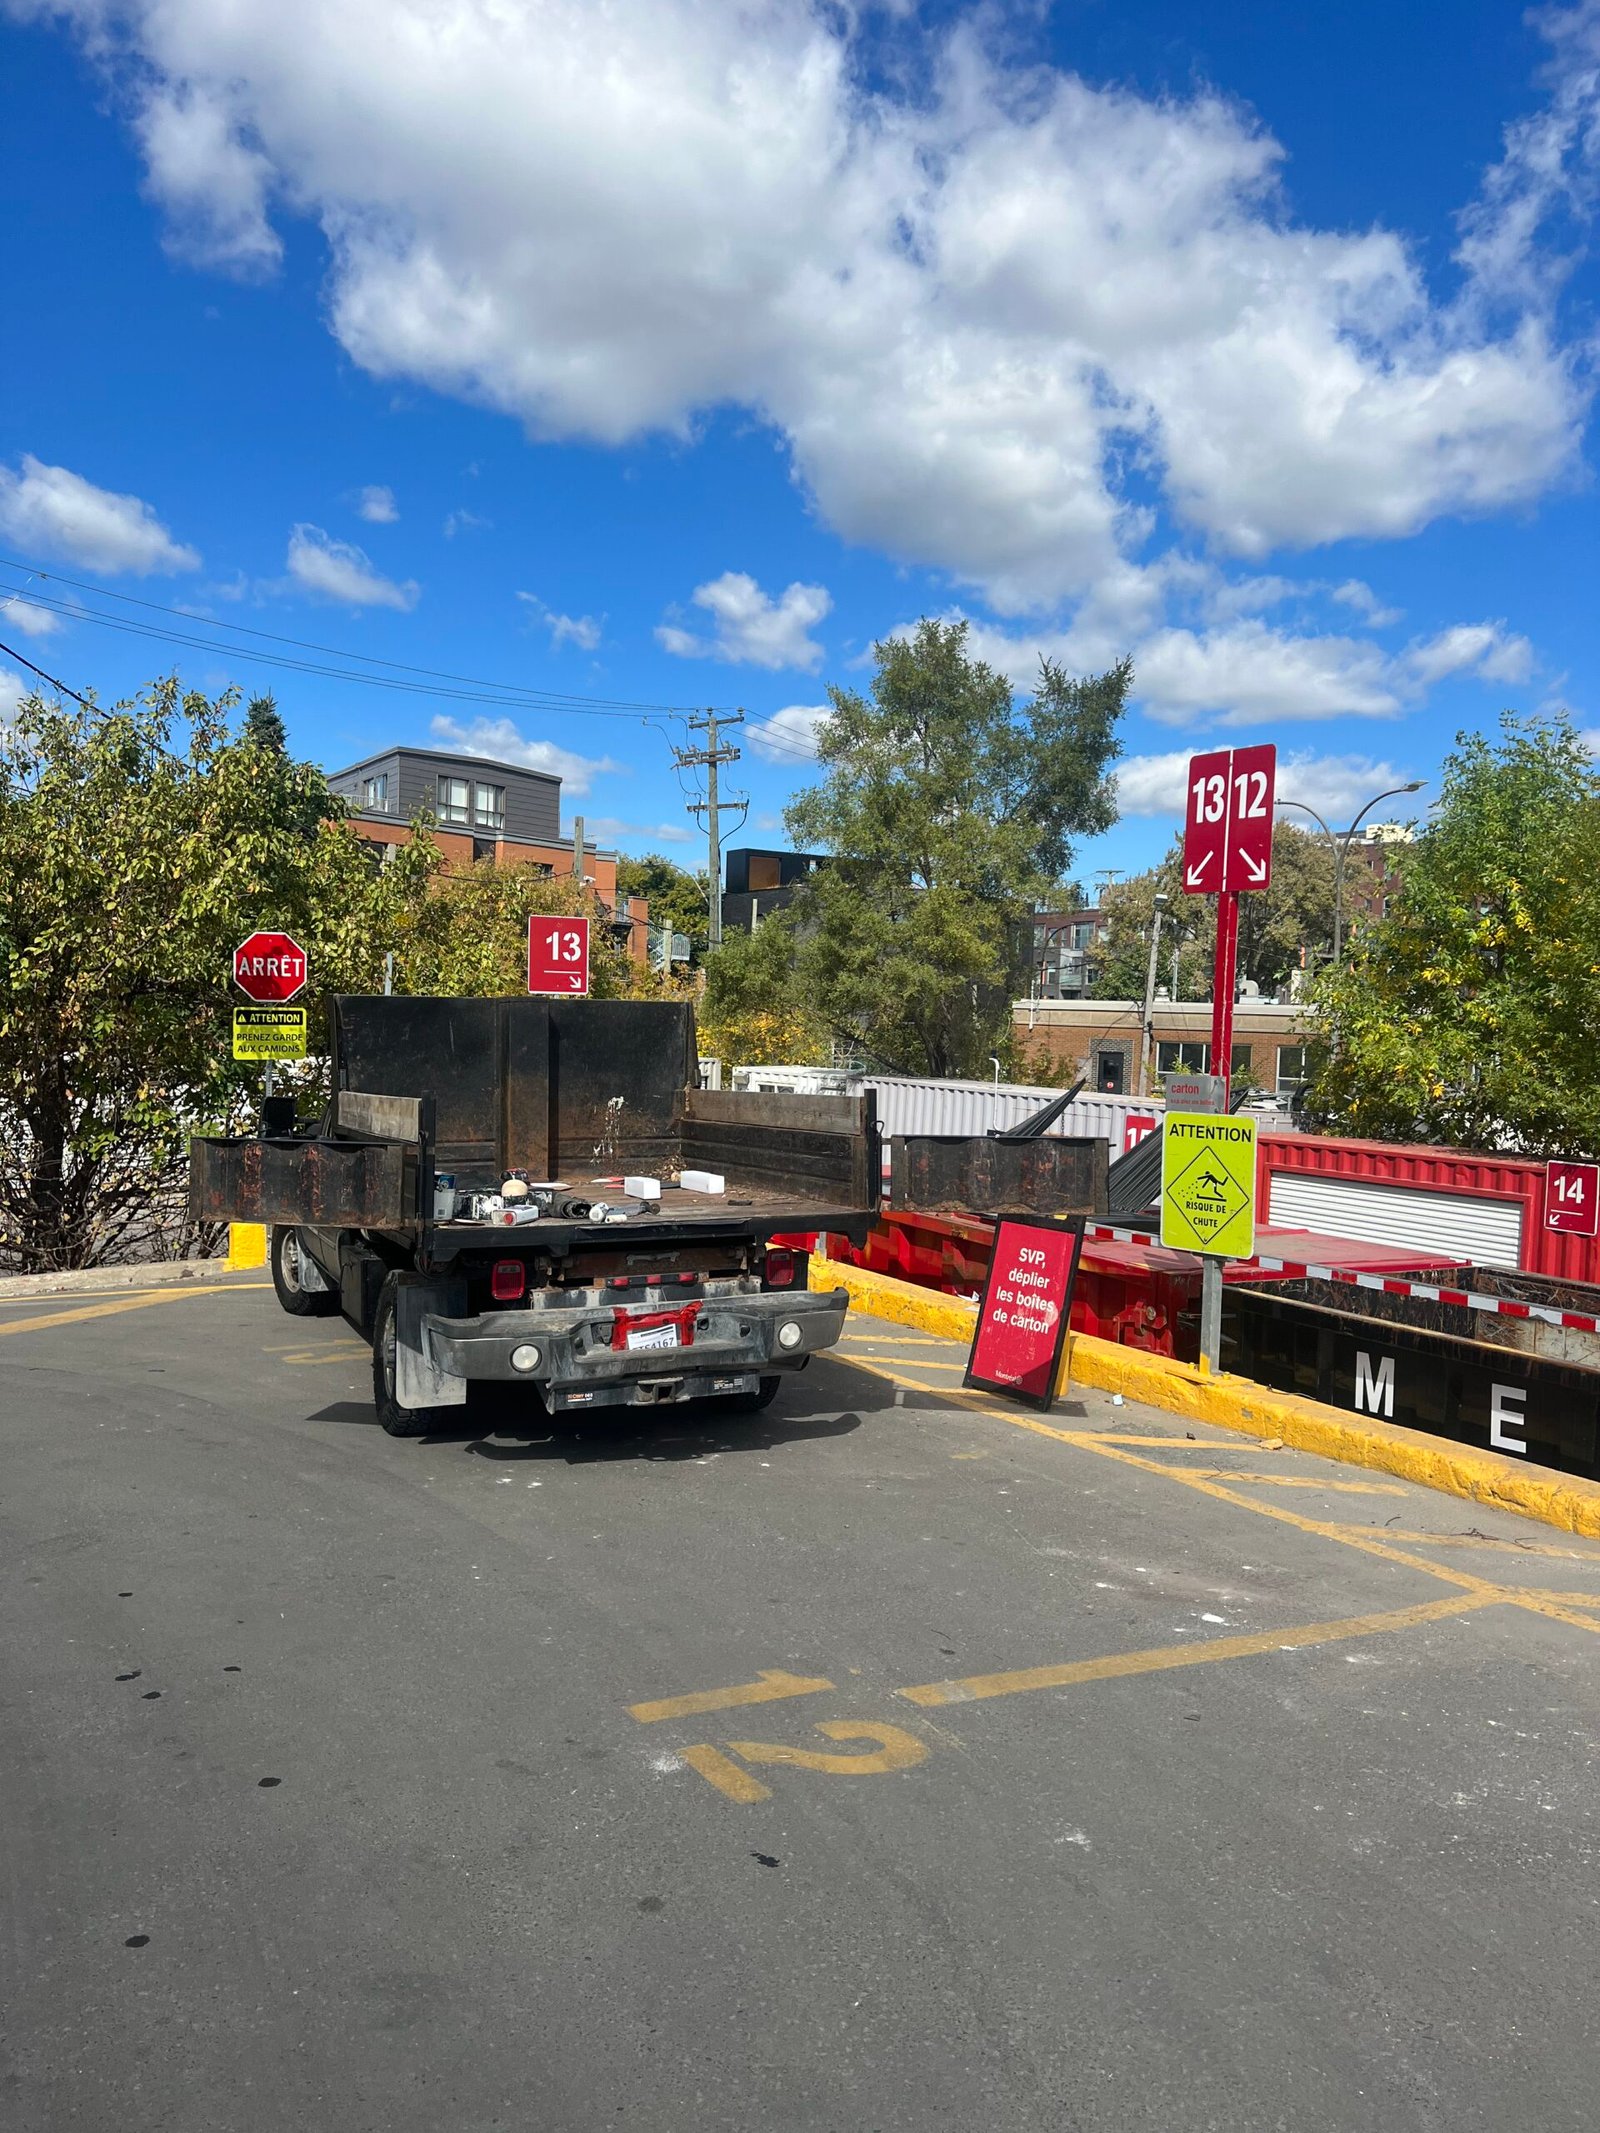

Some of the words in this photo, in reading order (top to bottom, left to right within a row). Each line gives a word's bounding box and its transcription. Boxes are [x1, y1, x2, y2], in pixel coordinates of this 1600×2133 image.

[1192, 774, 1225, 824] 13
[1234, 771, 1268, 819] 12
[546, 931, 582, 962] 13
[238, 955, 303, 977] ARRÊT
[249, 1013, 300, 1023] ATTENTION
[236, 1033, 271, 1042] PRENEZ
[272, 1033, 303, 1042] GARDE
[237, 1044, 257, 1053] AUX
[1171, 1084, 1199, 1095] carton
[1169, 1123, 1252, 1143] ATTENTION
[1554, 1175, 1585, 1204] 14
[1185, 1201, 1214, 1213] RISQUE
[1216, 1203, 1227, 1214] DE
[1193, 1216, 1218, 1228] CHUTE
[1018, 1247, 1046, 1269] SVP,
[1008, 1268, 1050, 1289] déplier
[996, 1286, 1013, 1303] les
[1016, 1291, 1054, 1312] boîtes
[992, 1308, 1007, 1323] de
[1010, 1314, 1049, 1334] carton
[623, 1668, 930, 1804] 12
